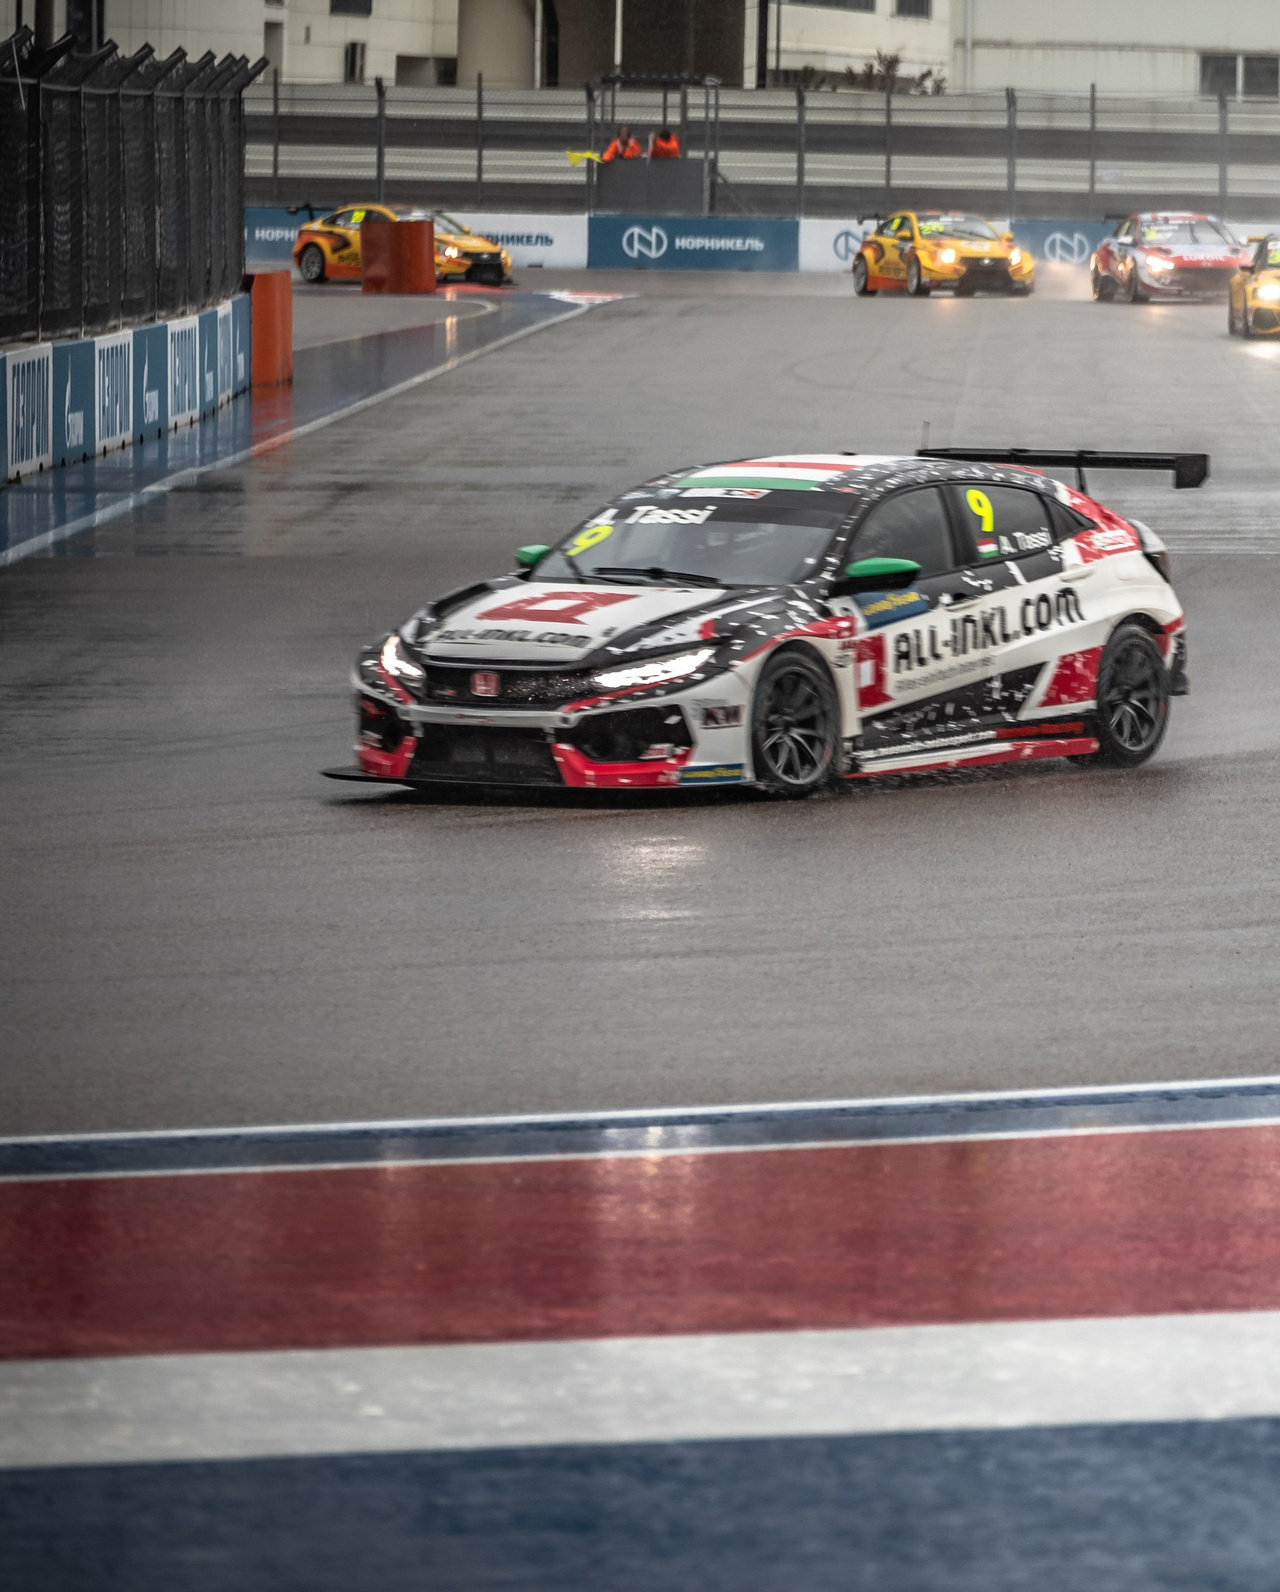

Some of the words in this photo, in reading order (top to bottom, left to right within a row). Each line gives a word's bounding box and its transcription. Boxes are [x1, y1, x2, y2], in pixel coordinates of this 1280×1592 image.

[674, 235, 765, 251] НОРНИКЕЛЬ
[624, 504, 718, 525] Tassi
[966, 489, 994, 532] 9
[563, 524, 614, 558] 9
[1012, 527, 1053, 551] Tassi
